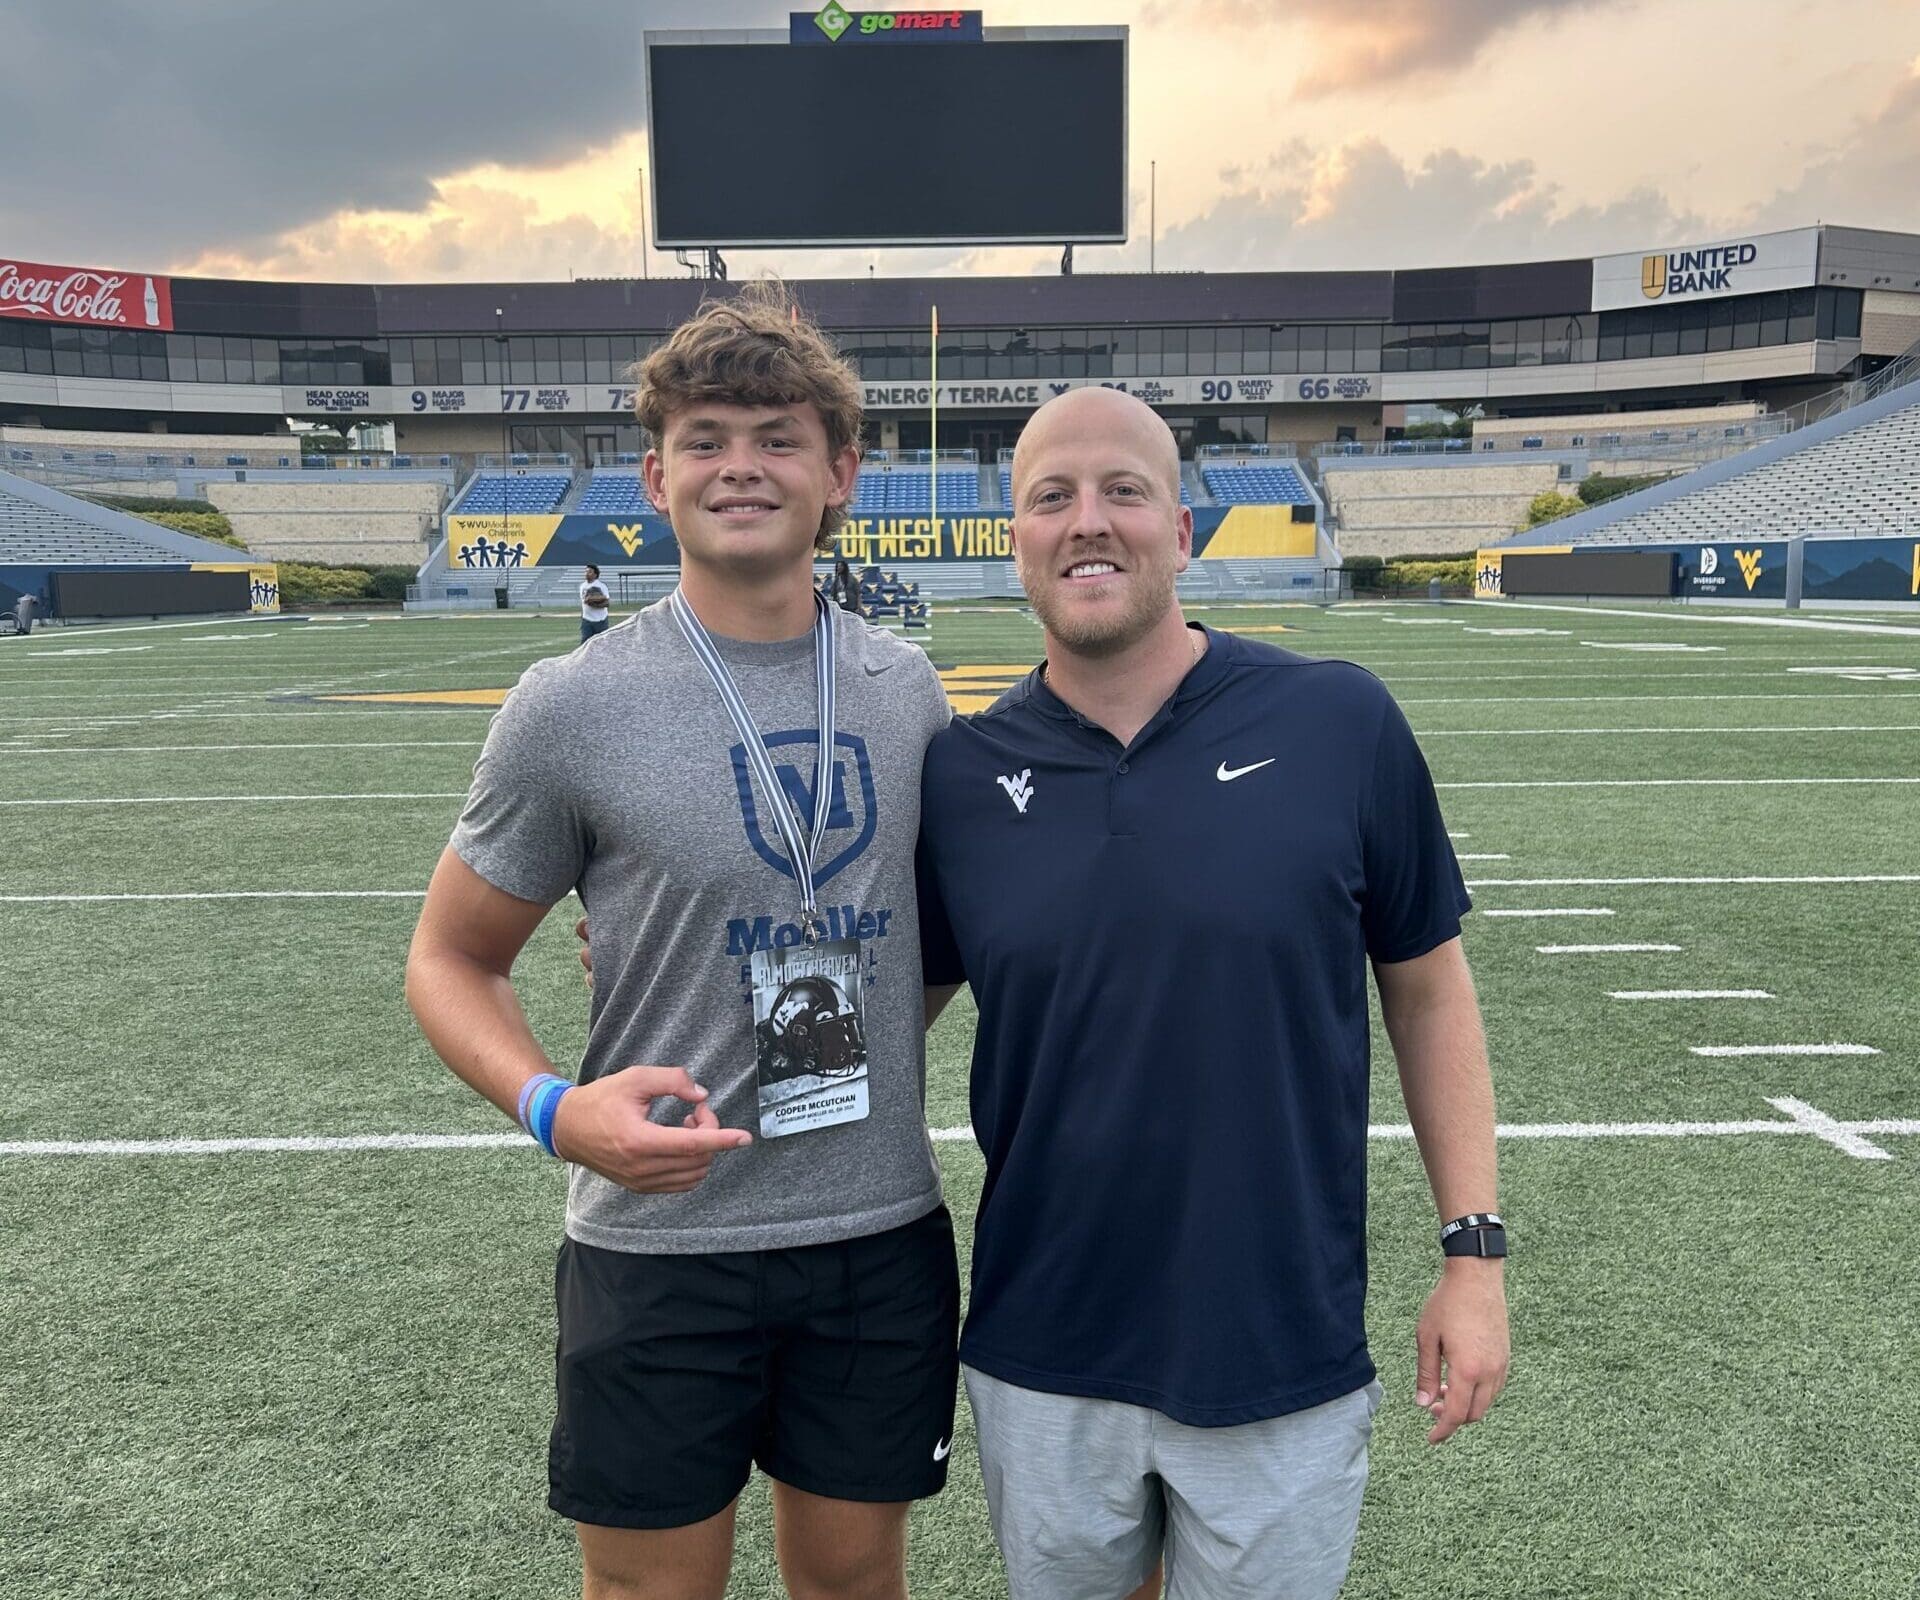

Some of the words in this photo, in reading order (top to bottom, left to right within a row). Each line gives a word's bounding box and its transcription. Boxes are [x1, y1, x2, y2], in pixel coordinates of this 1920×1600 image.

[860, 11, 962, 33] gomart
[1669, 243, 1757, 272] UNITED
[1668, 268, 1732, 294] BANK
[1201, 381, 1233, 401] 90
[1299, 379, 1330, 400] 66
[1337, 378, 1368, 386] CHUCK
[306, 390, 333, 399] HEAD
[336, 390, 369, 399] COACH
[307, 398, 328, 407] DON
[332, 398, 369, 407] NEHLEN
[411, 390, 427, 411] 9
[432, 390, 465, 398] MAJOR
[432, 398, 466, 407] HARRIS
[501, 390, 531, 411] 77
[865, 388, 942, 405] ENERGY
[948, 386, 1039, 404] TERRACE
[841, 520, 873, 558] OF
[879, 519, 945, 558] WEST
[951, 518, 1015, 557] VIRG
[775, 1105, 807, 1117] COOPER
[809, 1094, 856, 1110] MCCUTCHAN
